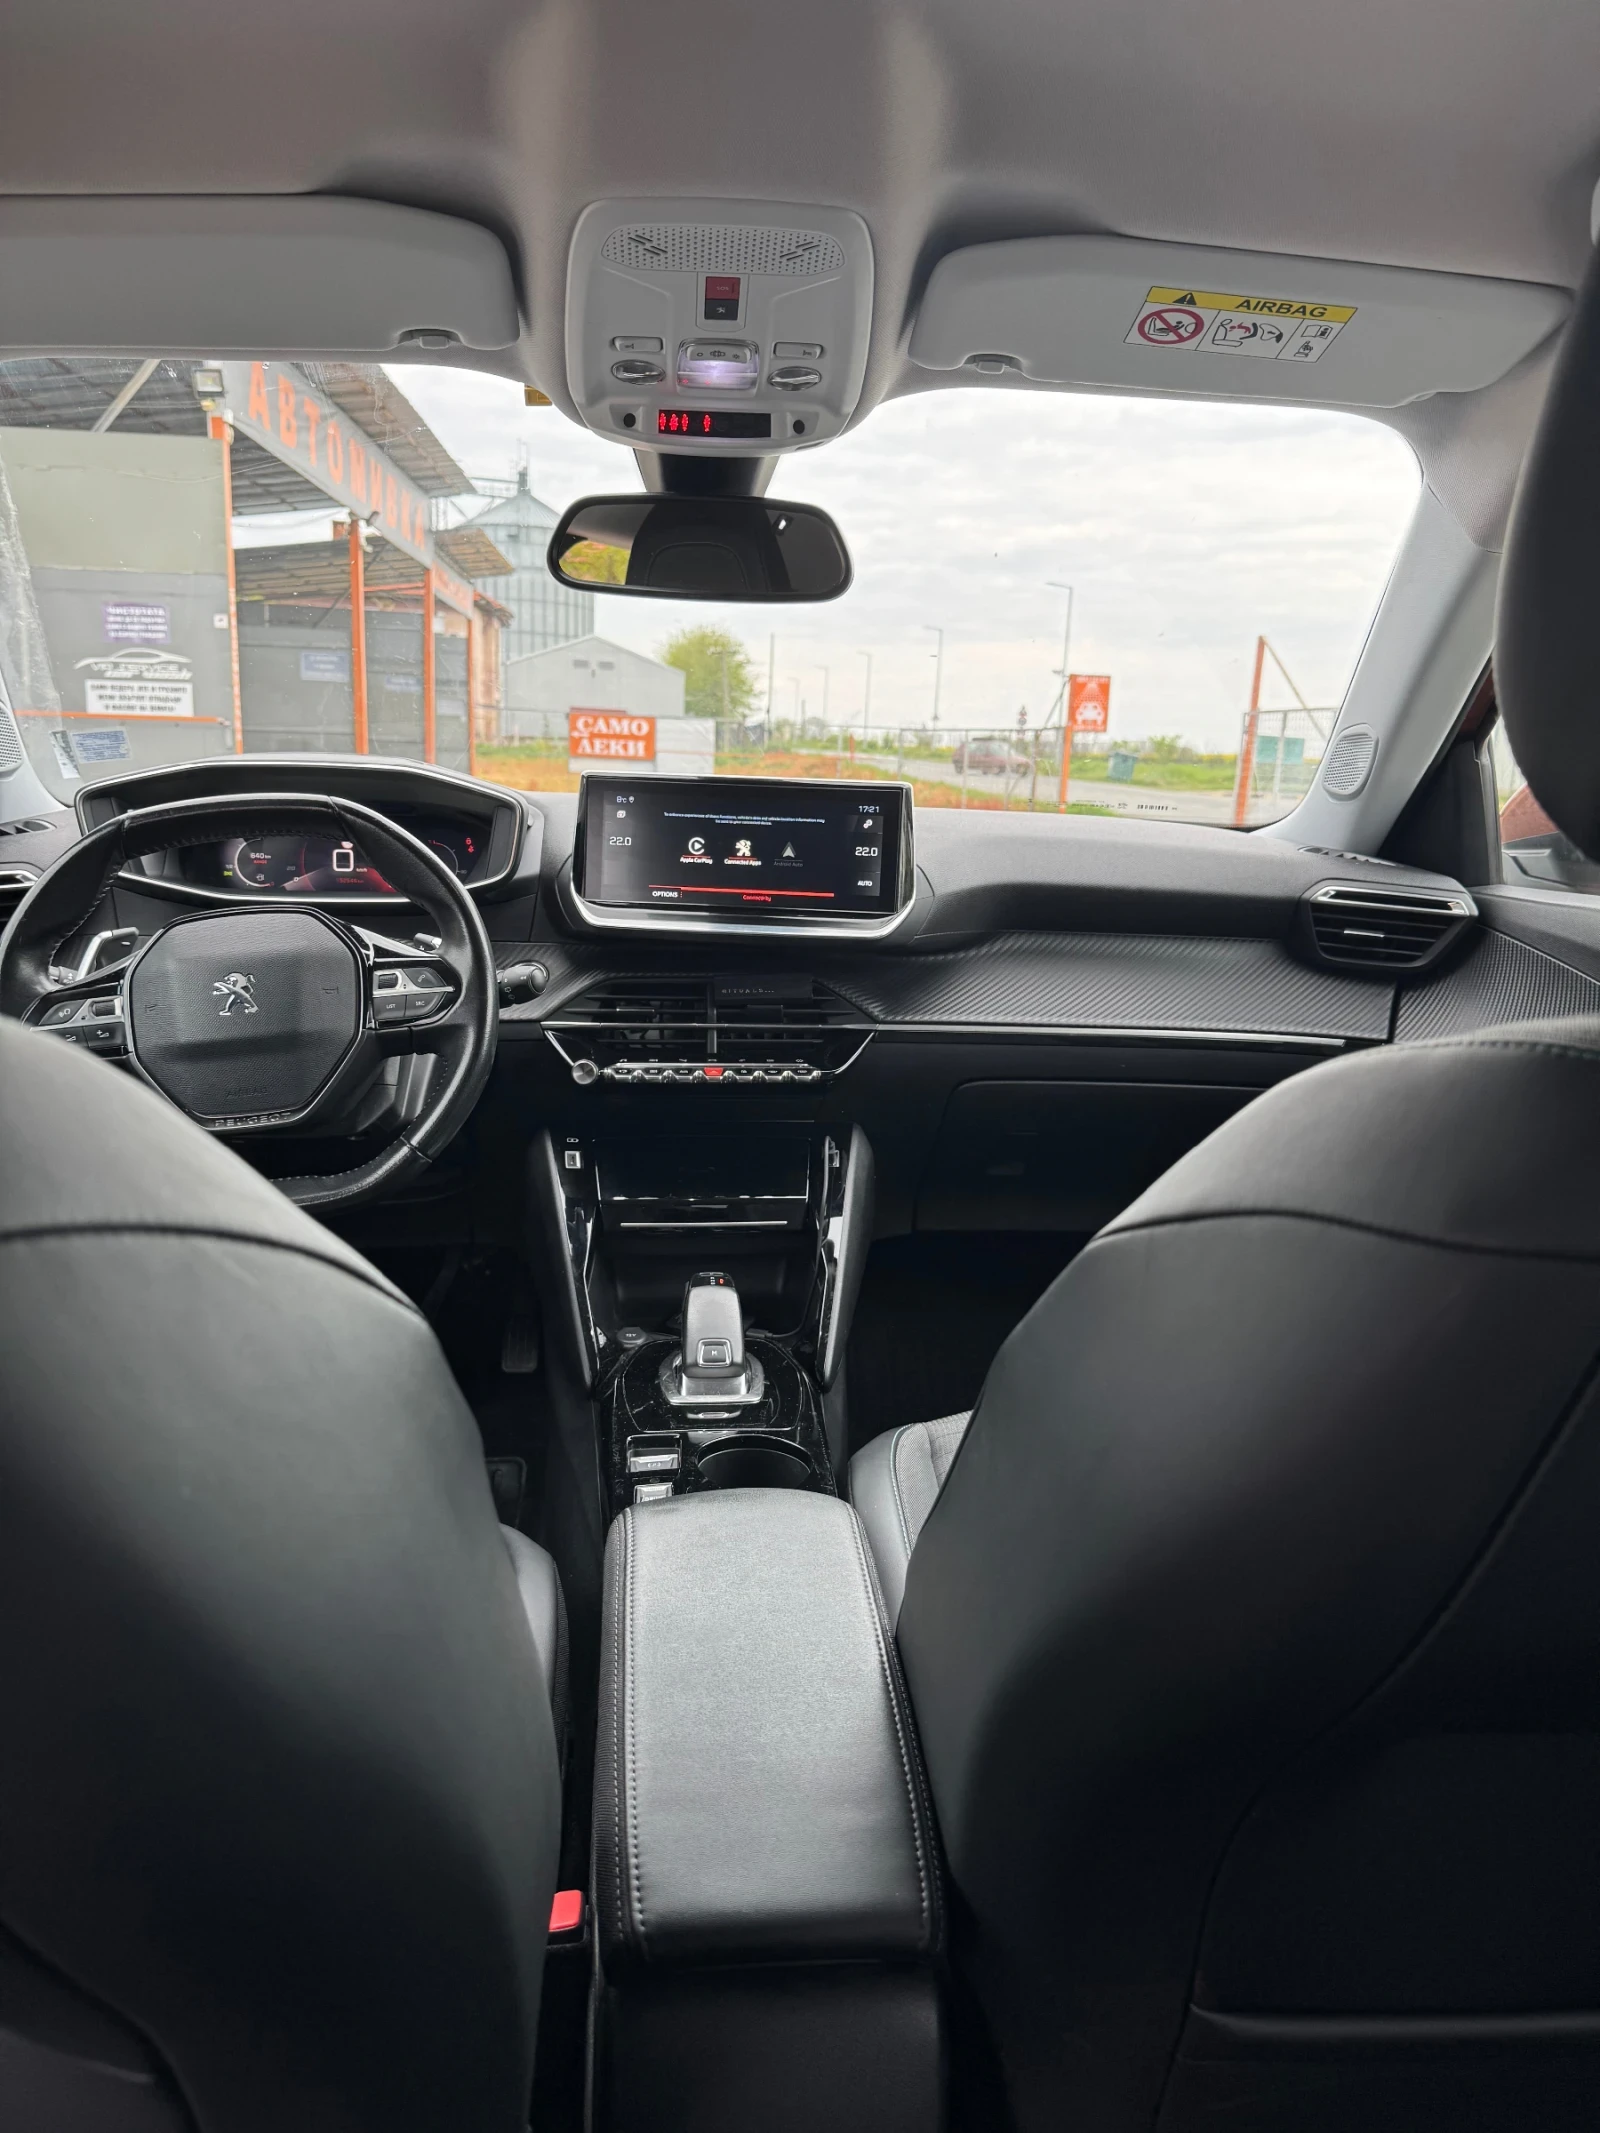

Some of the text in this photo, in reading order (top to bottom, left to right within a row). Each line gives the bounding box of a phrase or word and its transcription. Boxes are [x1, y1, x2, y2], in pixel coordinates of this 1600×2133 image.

[1235, 299, 1328, 318] AIRBAG
[575, 716, 649, 736] САМО
[577, 738, 646, 757] ЛЕКИ
[609, 836, 632, 846] 22.0
[855, 846, 878, 857] 22.0
[652, 890, 678, 898] OPTIONS
[215, 1112, 291, 1127] PEUGEOT
